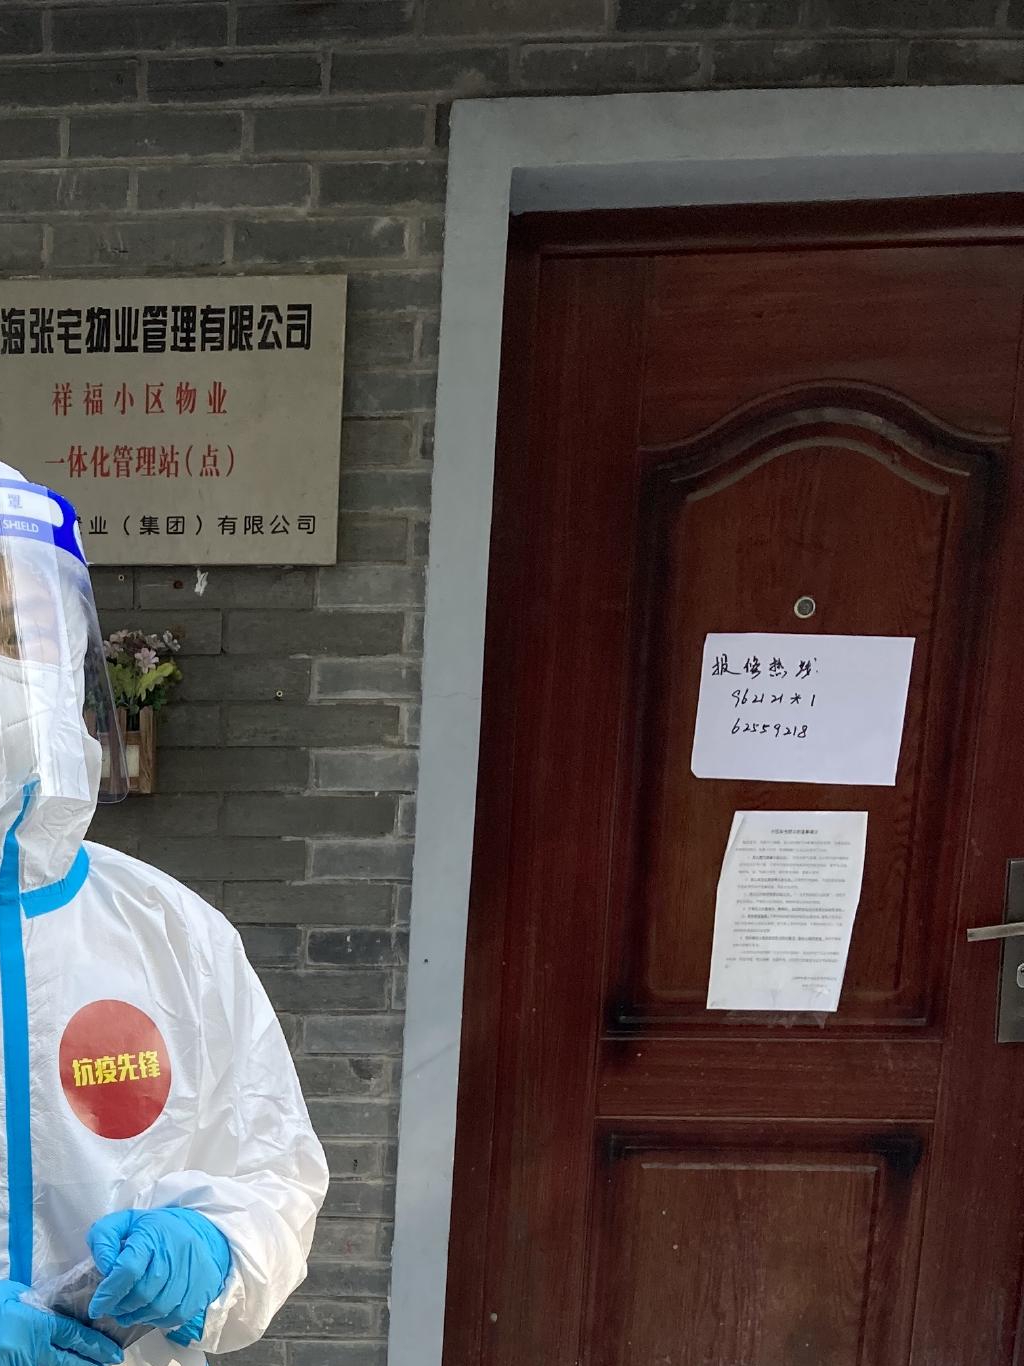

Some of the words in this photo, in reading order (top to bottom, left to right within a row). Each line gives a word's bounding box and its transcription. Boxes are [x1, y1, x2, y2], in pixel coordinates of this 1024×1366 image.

[52, 381, 228, 416] 祥福小区物业
[3, 520, 39, 533] SHIELD
[77, 515, 316, 537] 业（集团）有限公司
[731, 717, 808, 739] 62559218
[72, 1050, 161, 1087] 抗疫先锋
